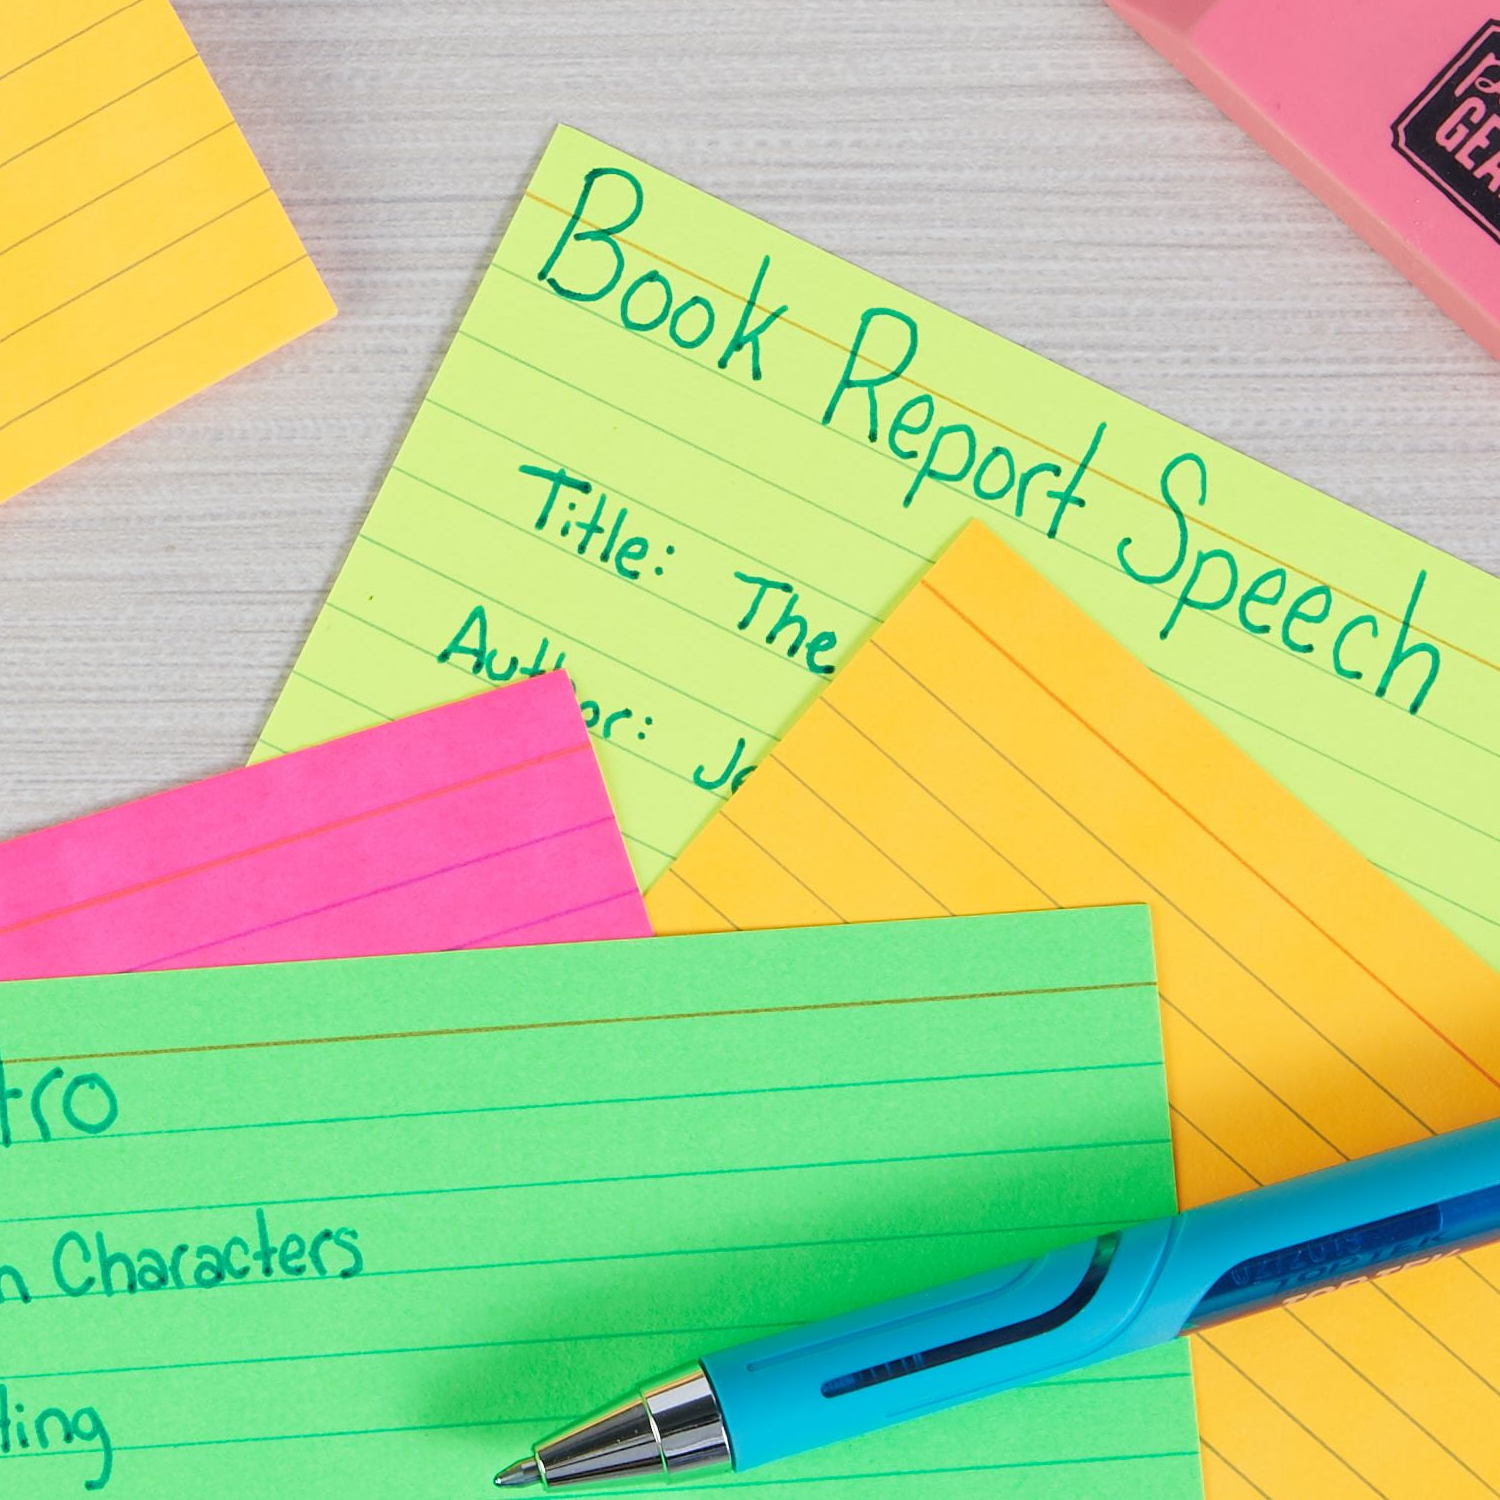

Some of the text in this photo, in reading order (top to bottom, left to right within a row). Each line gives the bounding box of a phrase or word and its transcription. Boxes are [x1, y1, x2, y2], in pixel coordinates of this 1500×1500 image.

[1435, 96, 1500, 198] GEA
[537, 167, 1441, 715] Book Report Speech
[518, 464, 836, 674] Title: The
[52, 1208, 364, 1297] Characters
